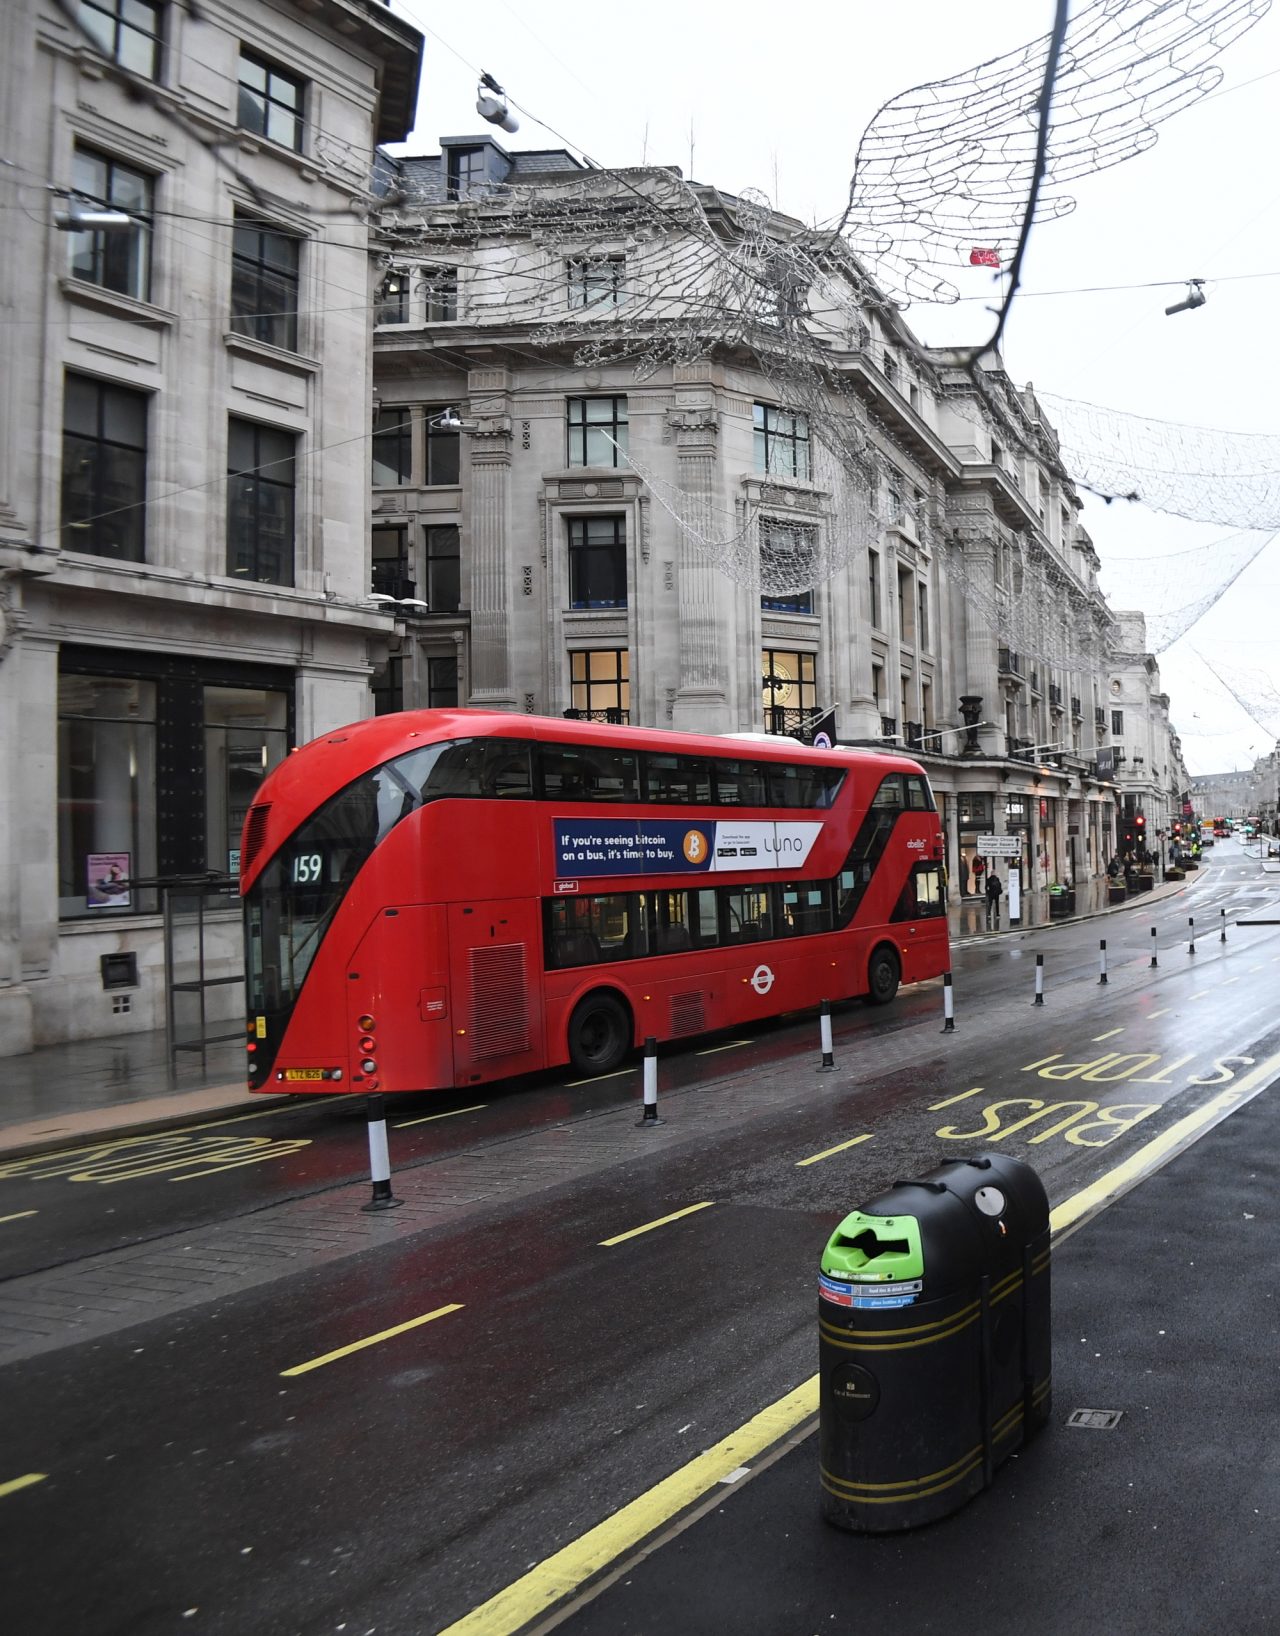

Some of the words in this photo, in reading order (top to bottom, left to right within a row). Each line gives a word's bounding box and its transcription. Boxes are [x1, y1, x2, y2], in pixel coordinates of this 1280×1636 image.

[561, 835, 570, 846] If
[572, 835, 602, 848] you're
[604, 835, 633, 847] seeing
[635, 834, 666, 845] bitcoin
[562, 851, 575, 861] on
[577, 852, 585, 860] a
[586, 849, 606, 861] bus,
[608, 849, 621, 859] it's
[623, 848, 644, 859] time
[646, 848, 656, 858] to
[657, 848, 675, 860] buy.
[293, 854, 323, 883] 159
[1036, 1053, 1254, 1084] STOP
[935, 1099, 1162, 1147] BUS
